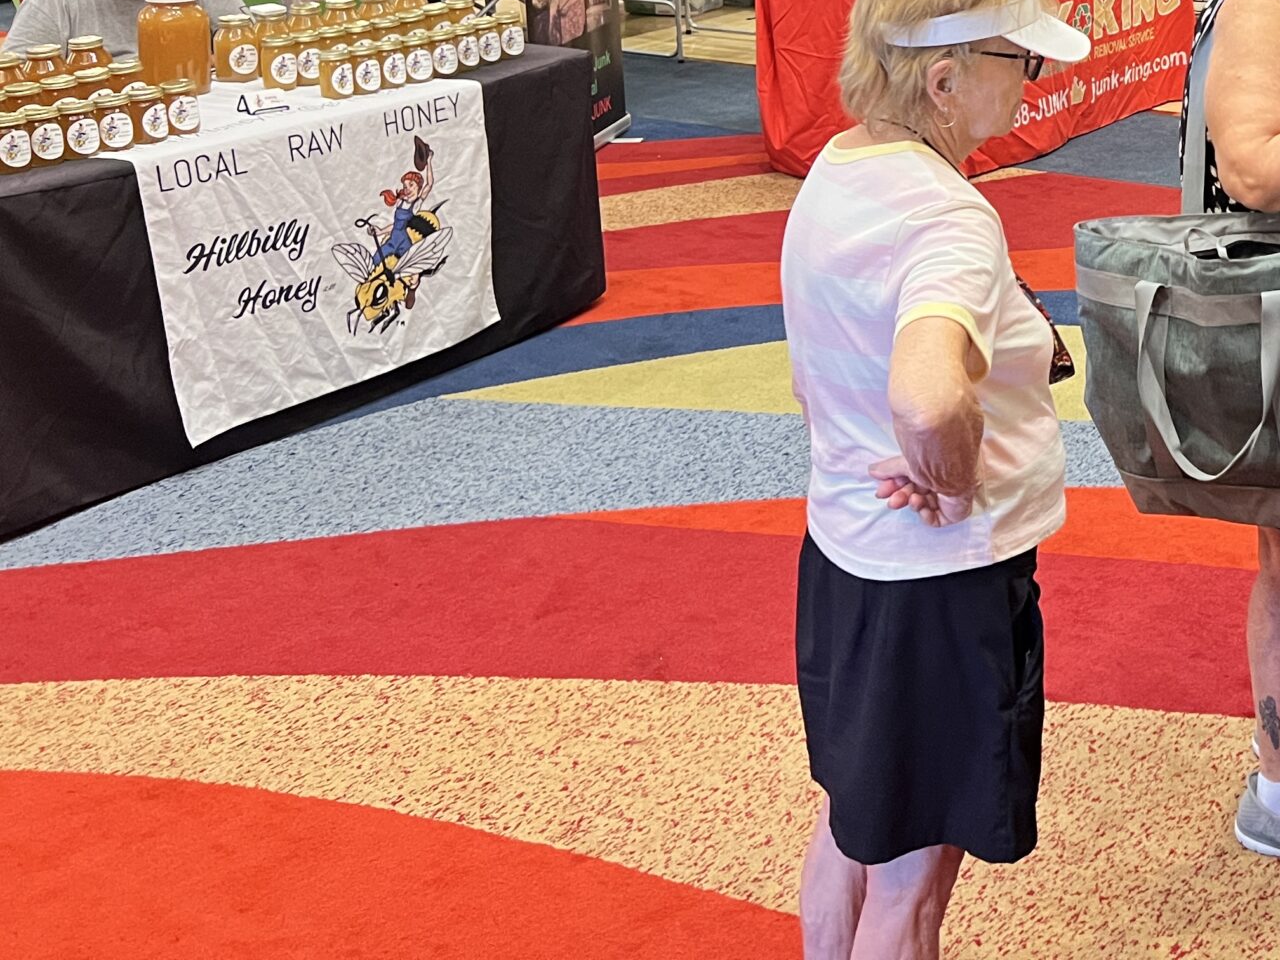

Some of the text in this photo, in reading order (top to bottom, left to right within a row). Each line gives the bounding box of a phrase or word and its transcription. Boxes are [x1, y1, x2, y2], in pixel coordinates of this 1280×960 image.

[1093, 38, 1128, 59] REMOVAL
[1091, 50, 1188, 103] junk-king.com
[156, 92, 461, 193] LOCAL RAW HONEY
[183, 218, 310, 275] Hillbilly
[233, 275, 323, 320] Honey
